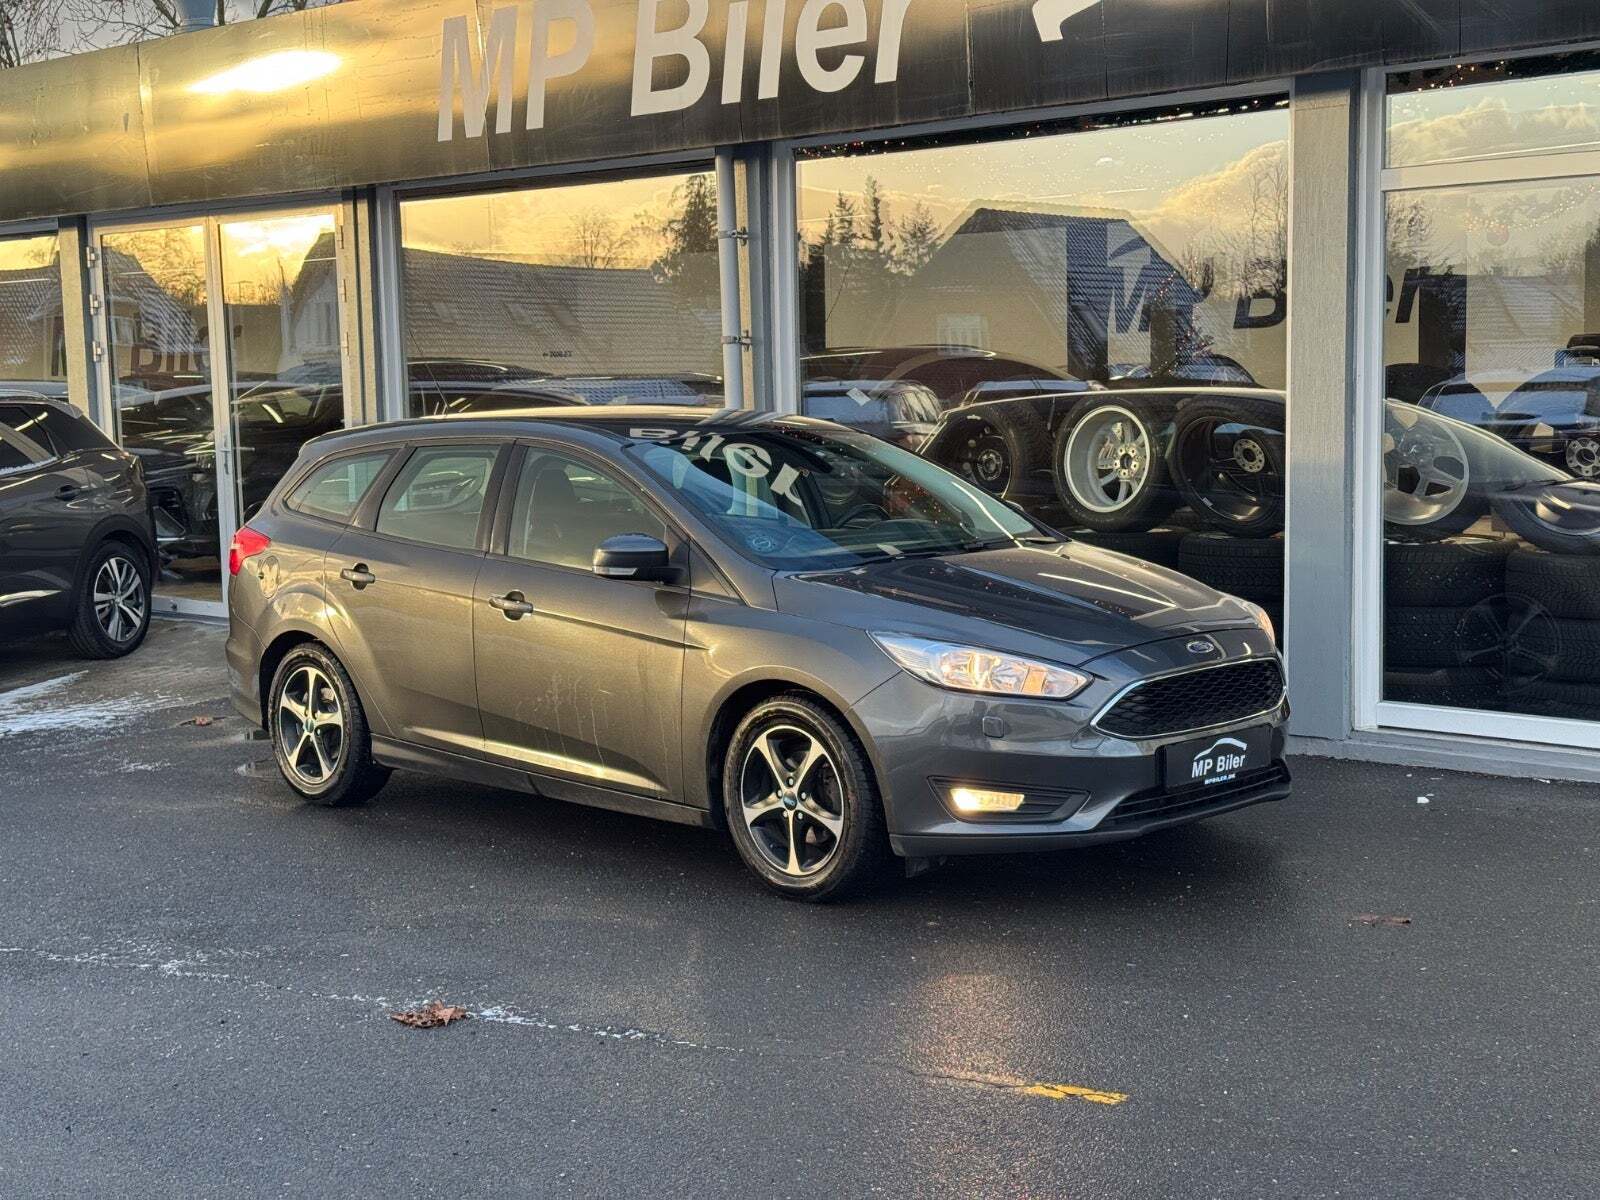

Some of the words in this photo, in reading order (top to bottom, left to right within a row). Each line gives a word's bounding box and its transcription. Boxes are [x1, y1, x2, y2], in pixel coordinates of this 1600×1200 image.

[437, 0, 595, 142] MP
[630, 0, 906, 117] Biler
[1191, 758, 1213, 778] MP
[1216, 754, 1245, 772] Biler
